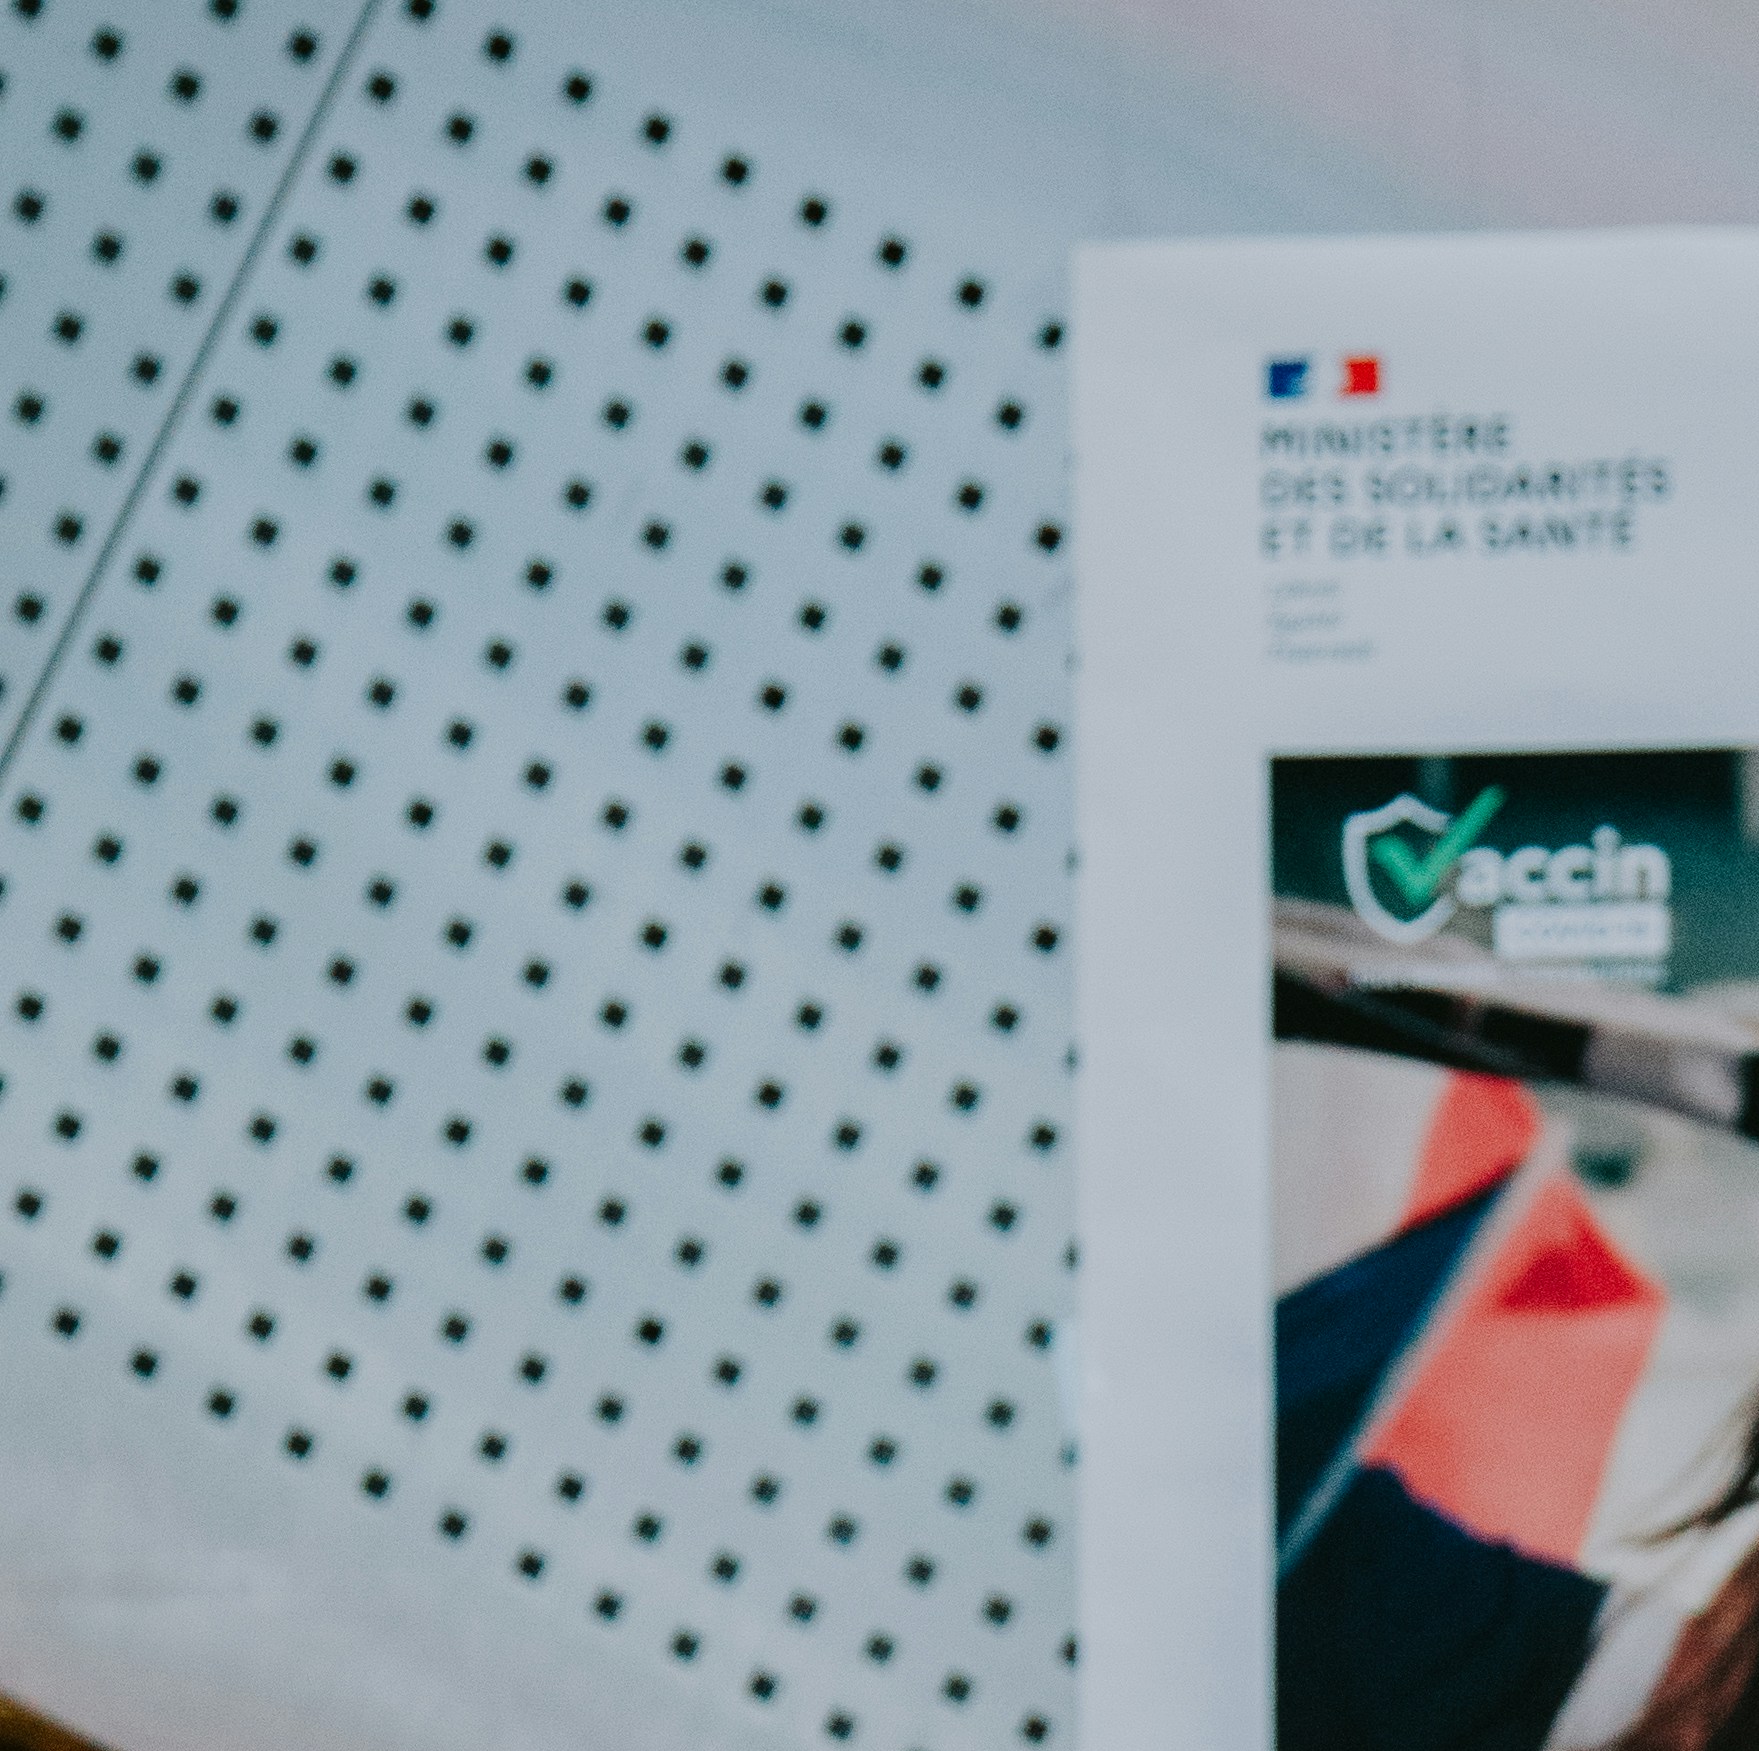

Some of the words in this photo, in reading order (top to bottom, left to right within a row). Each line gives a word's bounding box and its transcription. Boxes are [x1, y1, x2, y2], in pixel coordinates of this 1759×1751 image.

[1260, 414, 1510, 456] MINISTÈRE
[1260, 468, 1348, 507] DES
[1367, 453, 1671, 504] SOLIDARITÉS
[1260, 518, 1312, 557] ET
[1330, 518, 1388, 556] DE
[1406, 514, 1466, 553] LA
[1484, 506, 1634, 553] SANTÉ
